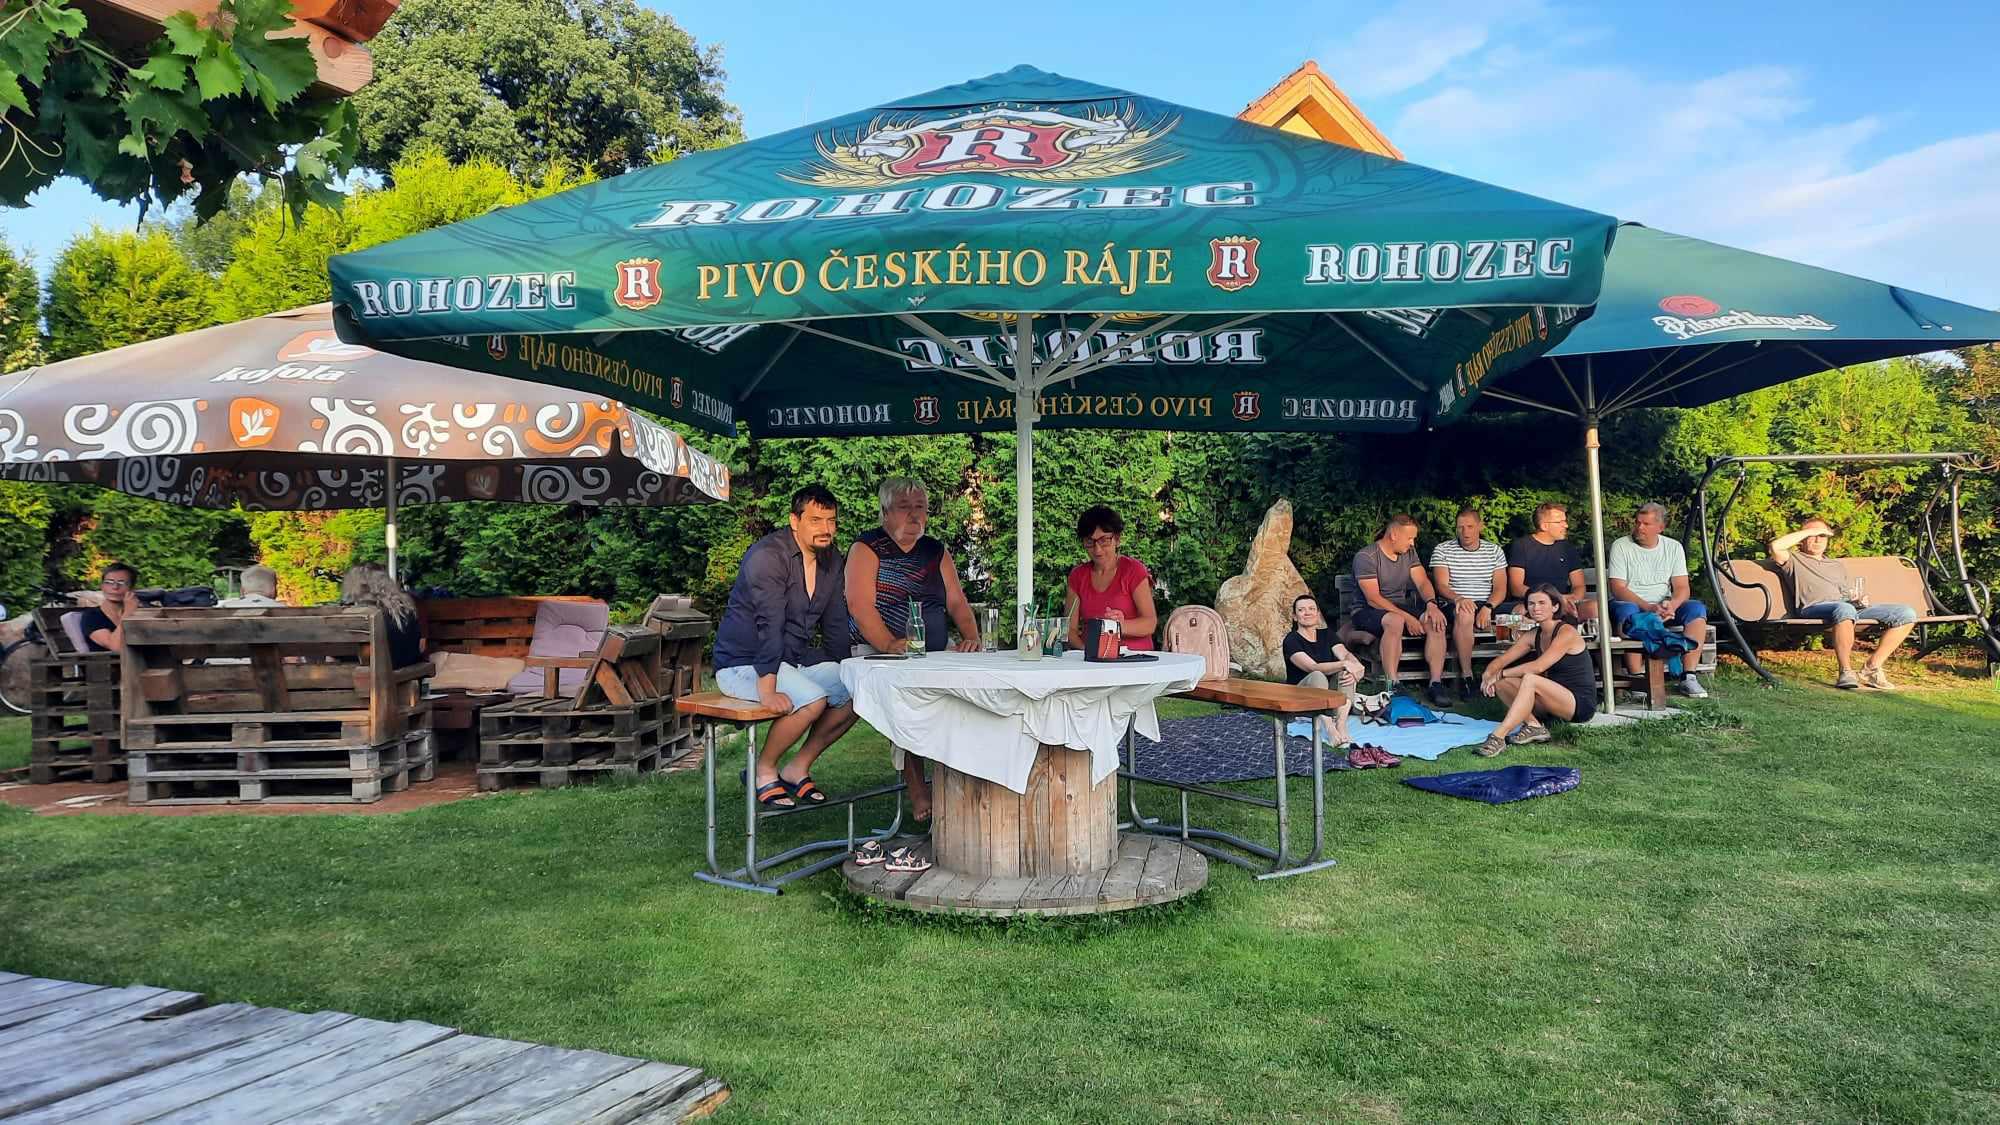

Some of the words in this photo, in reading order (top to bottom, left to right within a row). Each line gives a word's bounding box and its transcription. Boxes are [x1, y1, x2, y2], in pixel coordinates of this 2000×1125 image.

[916, 127, 1043, 168] R
[634, 182, 1256, 229] ROHOZEC
[624, 267, 653, 299] R
[697, 259, 806, 300] PIVO
[818, 242, 1047, 292] ČESKÉHO
[1064, 242, 1172, 295] RÁJE
[1217, 245, 1249, 279] R
[1305, 238, 1572, 284] ROHOZEC
[353, 271, 576, 317] ROHOZEC
